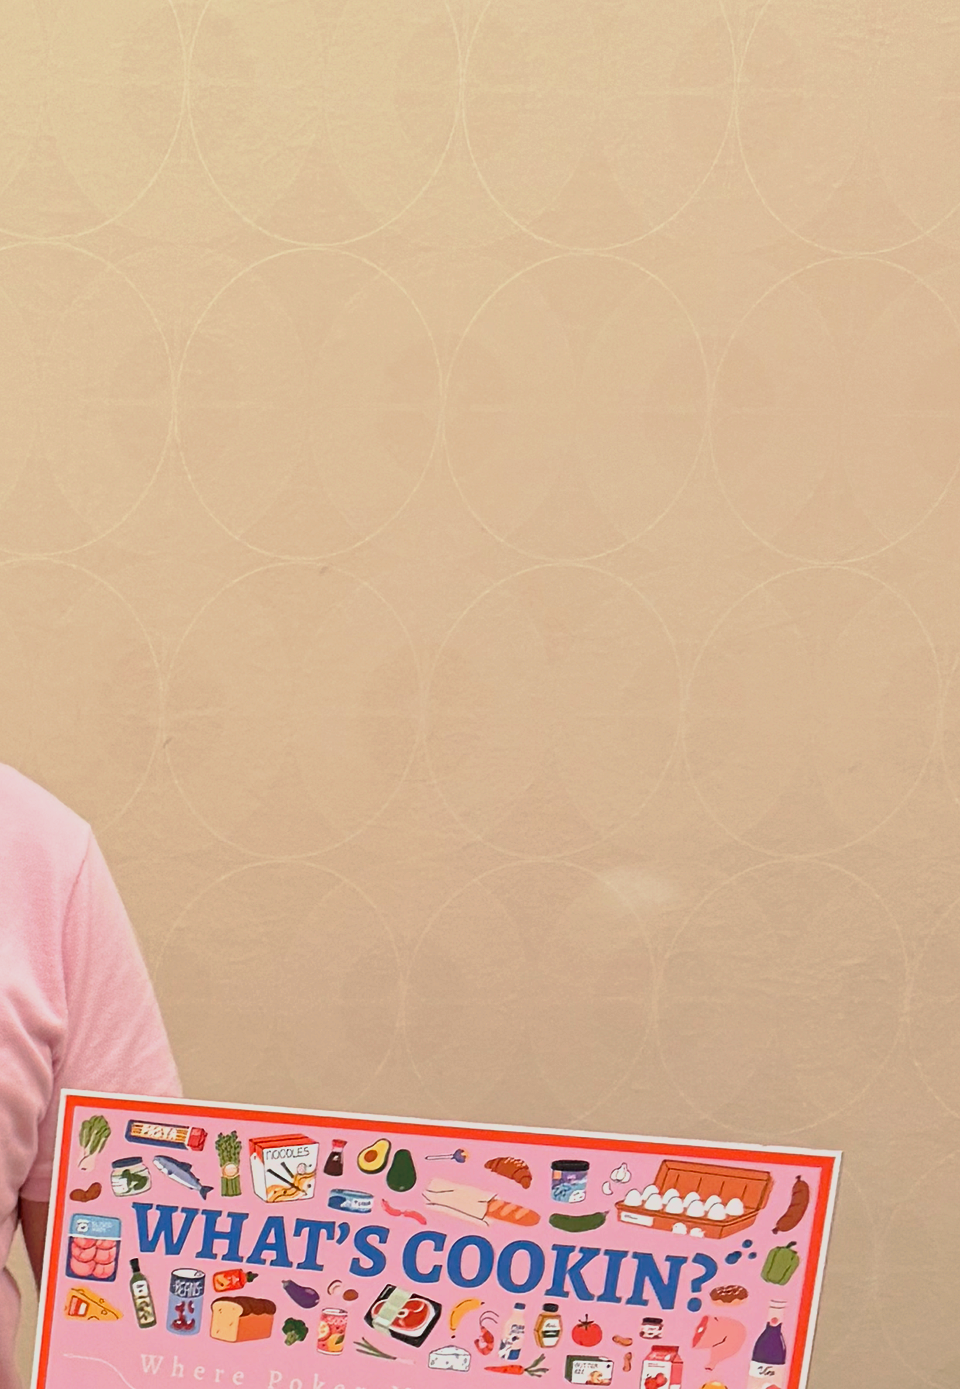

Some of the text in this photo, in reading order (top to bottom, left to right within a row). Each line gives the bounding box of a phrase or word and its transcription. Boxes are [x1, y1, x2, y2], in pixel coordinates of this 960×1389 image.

[265, 1146, 310, 1161] NOODLES
[131, 1202, 718, 1312] WHAT'S COOKIN?
[140, 1354, 244, 1385] Where
